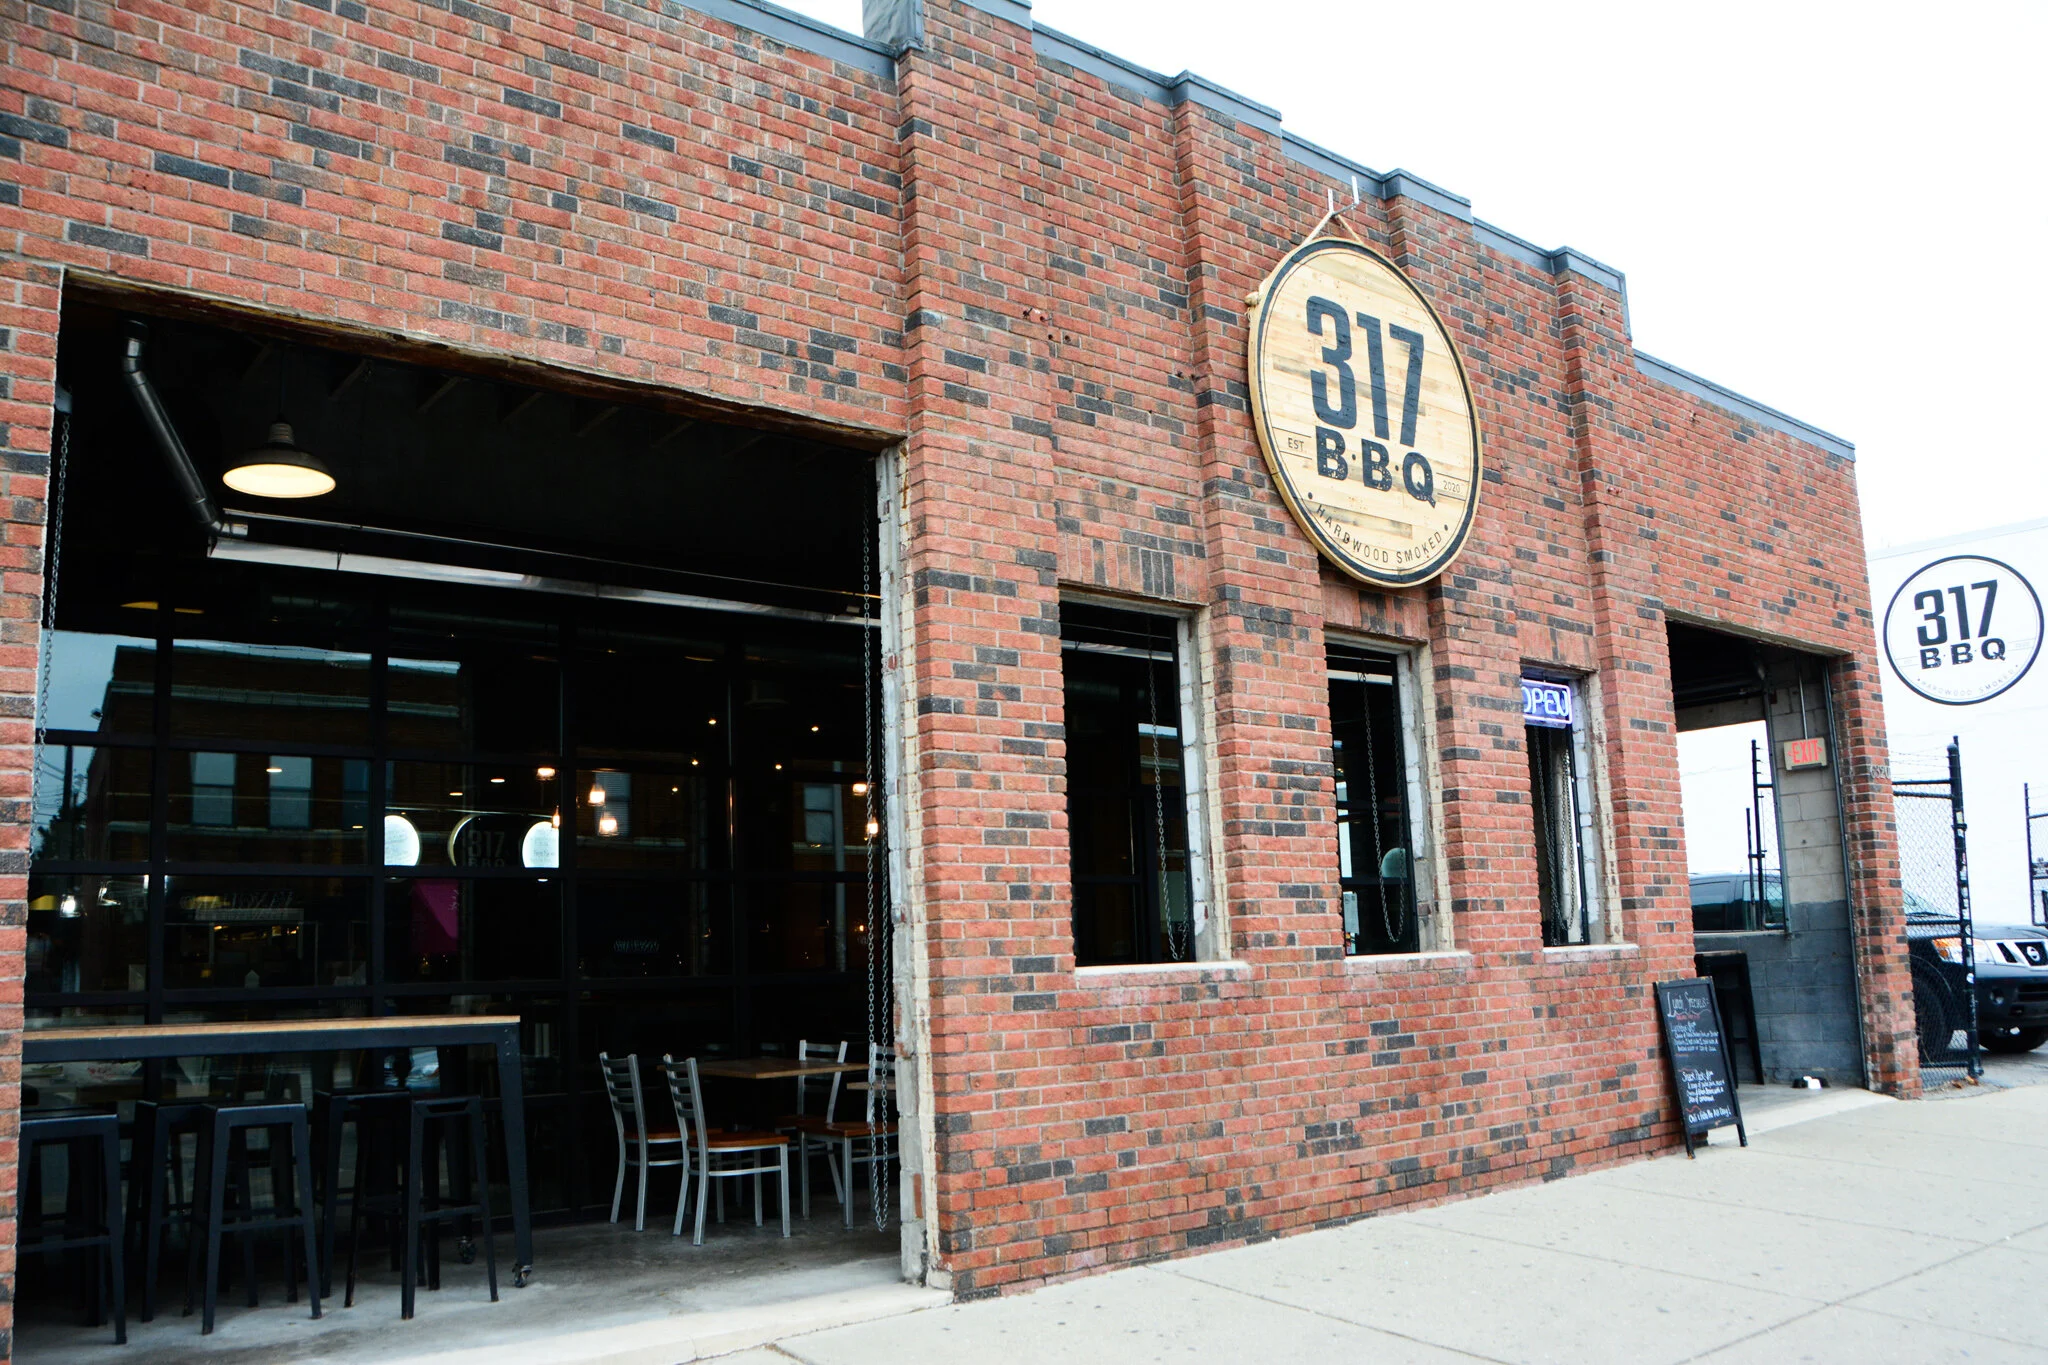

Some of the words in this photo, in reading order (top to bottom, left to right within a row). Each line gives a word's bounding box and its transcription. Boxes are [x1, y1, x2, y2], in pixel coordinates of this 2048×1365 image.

[1306, 295, 1424, 448] 317
[1443, 480, 1461, 494] 2020
[1316, 504, 1389, 564] HARDWOOD
[1396, 531, 1443, 564] SMOKED
[1913, 579, 1998, 647] 317
[1791, 739, 1819, 764] EXIT
